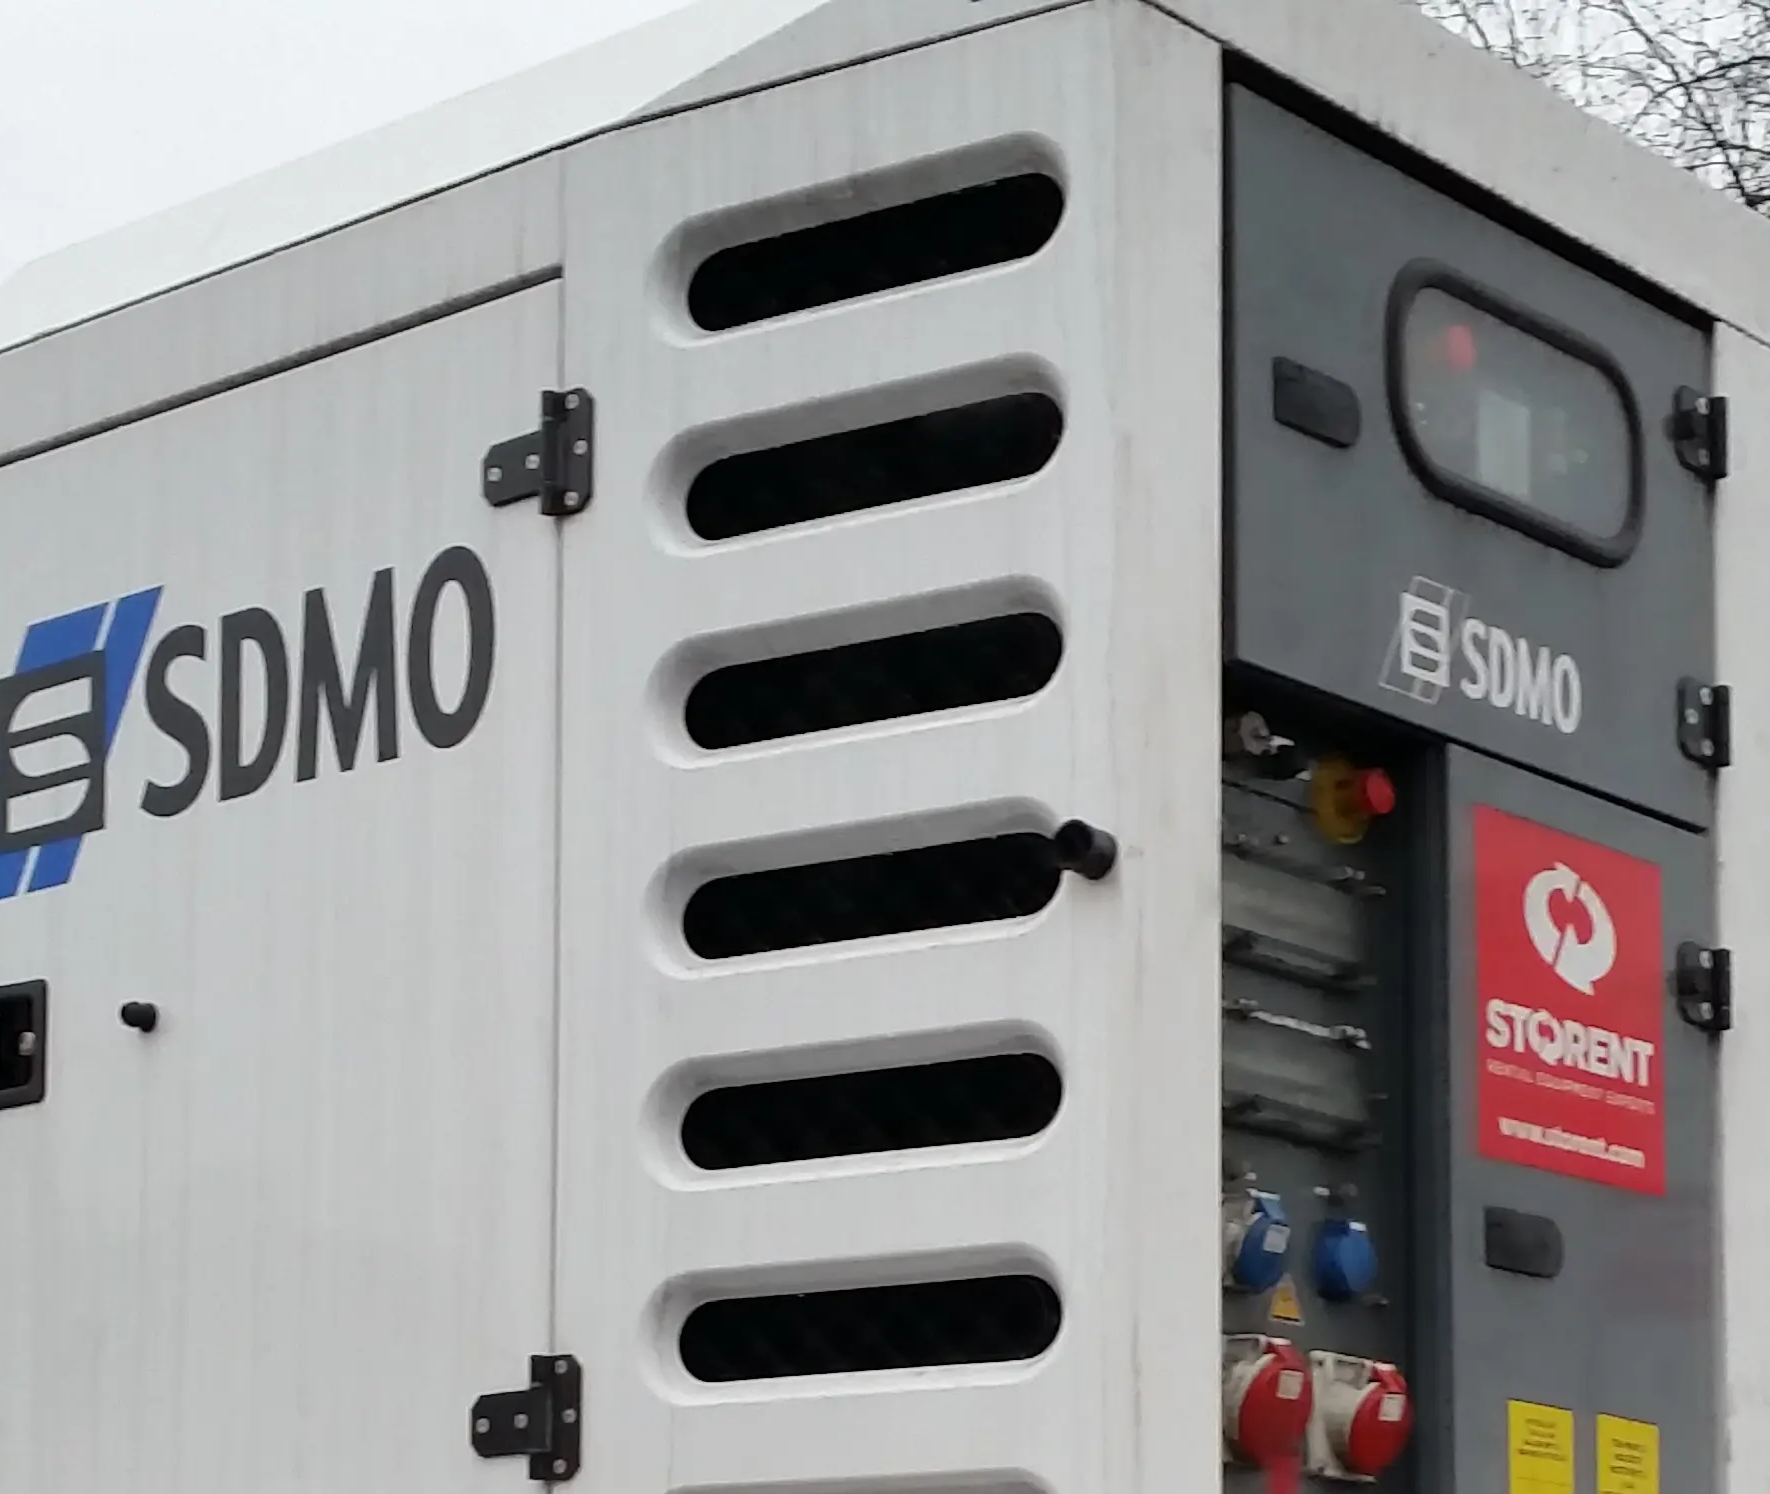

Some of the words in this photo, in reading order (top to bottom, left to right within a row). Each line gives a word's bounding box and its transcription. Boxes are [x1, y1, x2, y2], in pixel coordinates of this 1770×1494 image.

[139, 543, 498, 818] SDMO
[1460, 616, 1583, 734] SDMO
[1485, 998, 1655, 1087] STORENT
